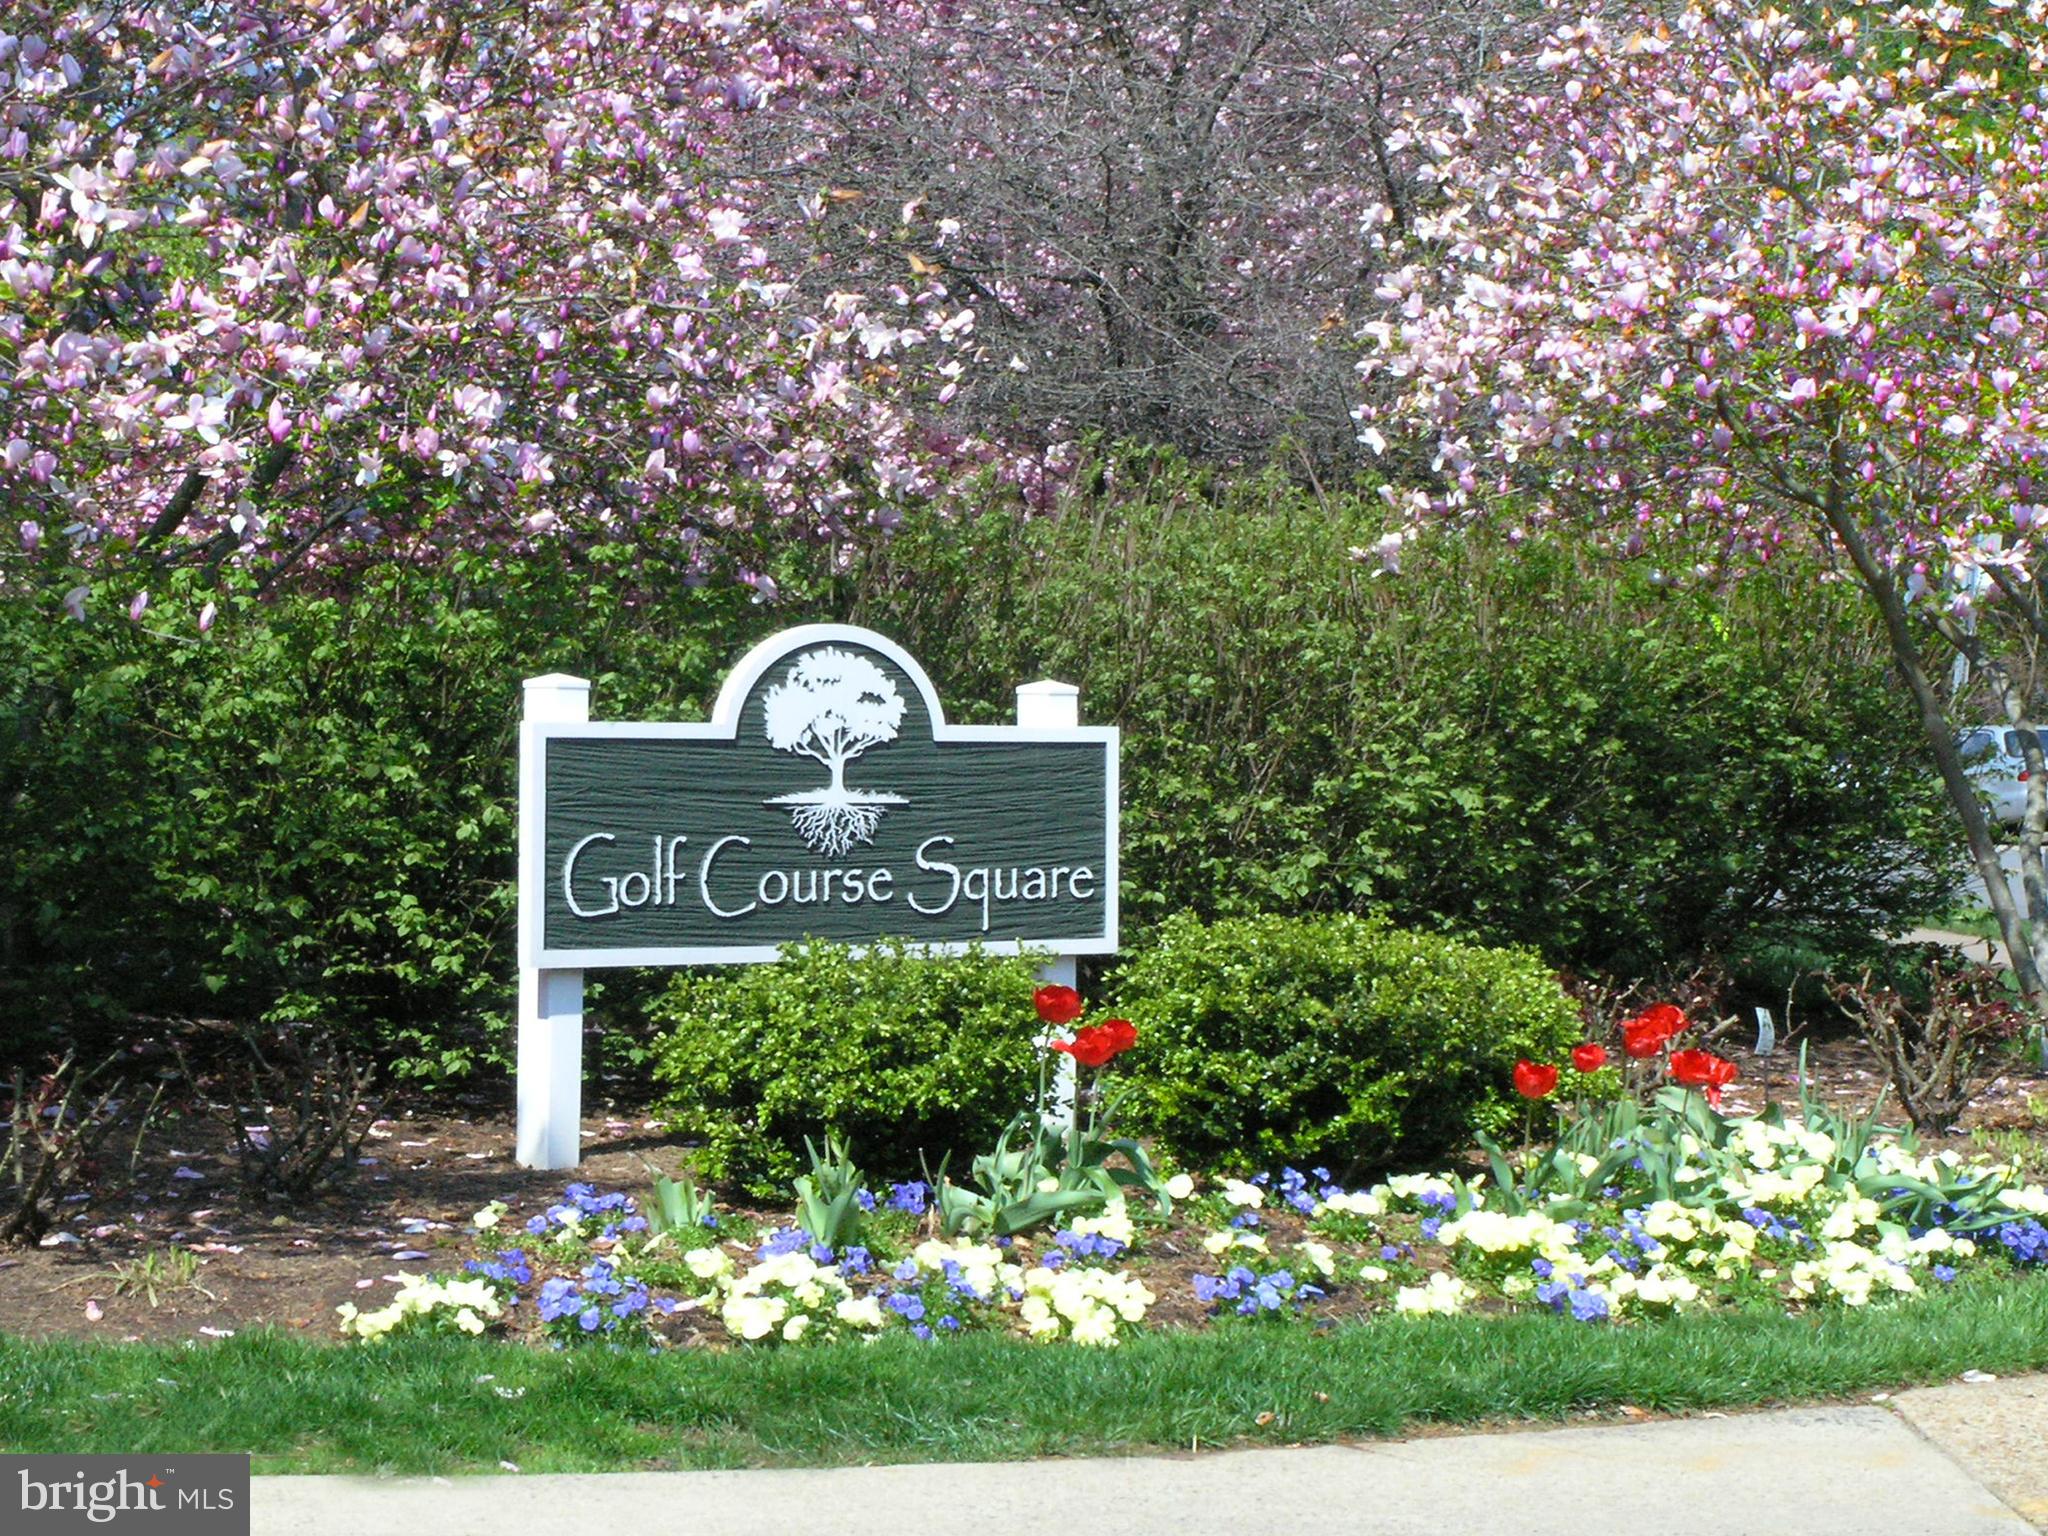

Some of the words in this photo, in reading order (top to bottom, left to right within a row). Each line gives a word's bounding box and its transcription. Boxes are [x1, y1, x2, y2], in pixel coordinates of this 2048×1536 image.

[561, 832, 688, 918] Golf
[698, 835, 894, 918] Course
[907, 835, 1096, 932] Square
